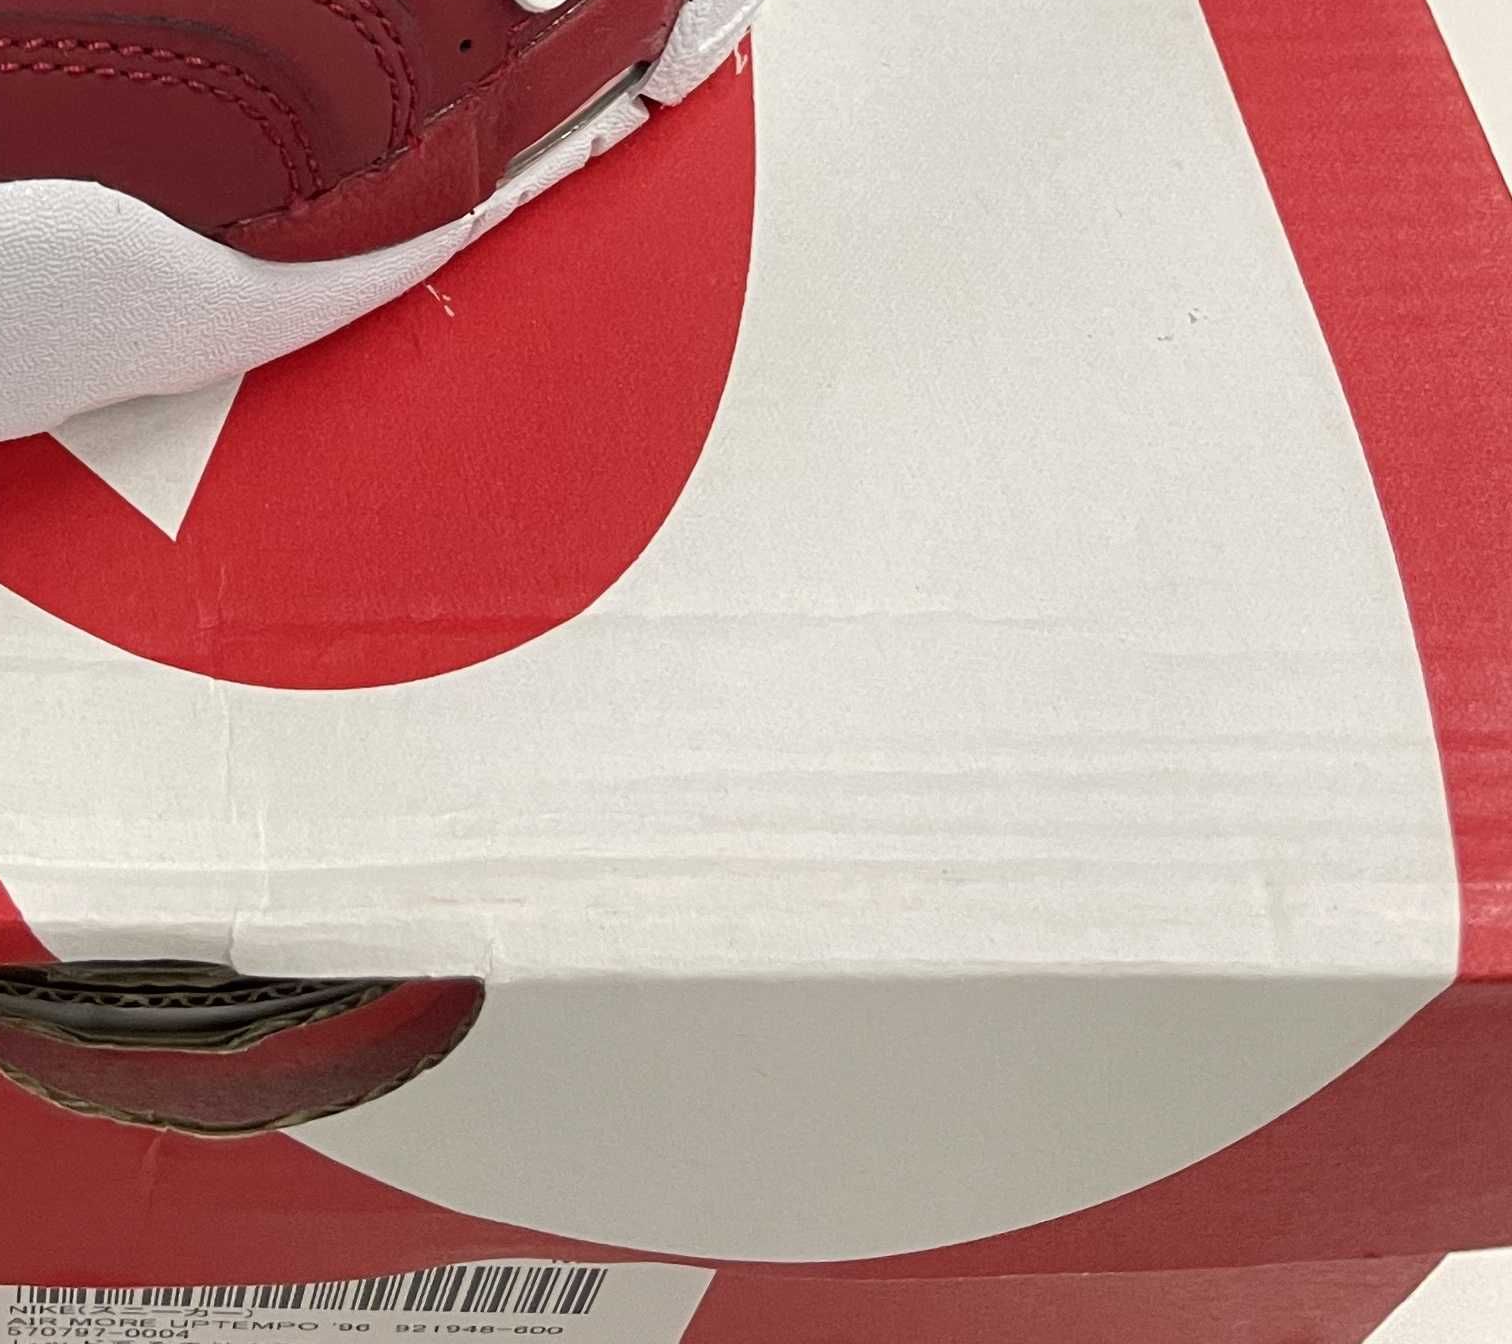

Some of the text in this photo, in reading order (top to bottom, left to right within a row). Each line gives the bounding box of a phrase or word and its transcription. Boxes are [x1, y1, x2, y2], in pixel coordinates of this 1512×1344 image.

[8, 1317, 56, 1326] AIR
[70, 1318, 156, 1327] MORE
[170, 1319, 319, 1331] UPTEMPO
[395, 1323, 564, 1335] 921948-600
